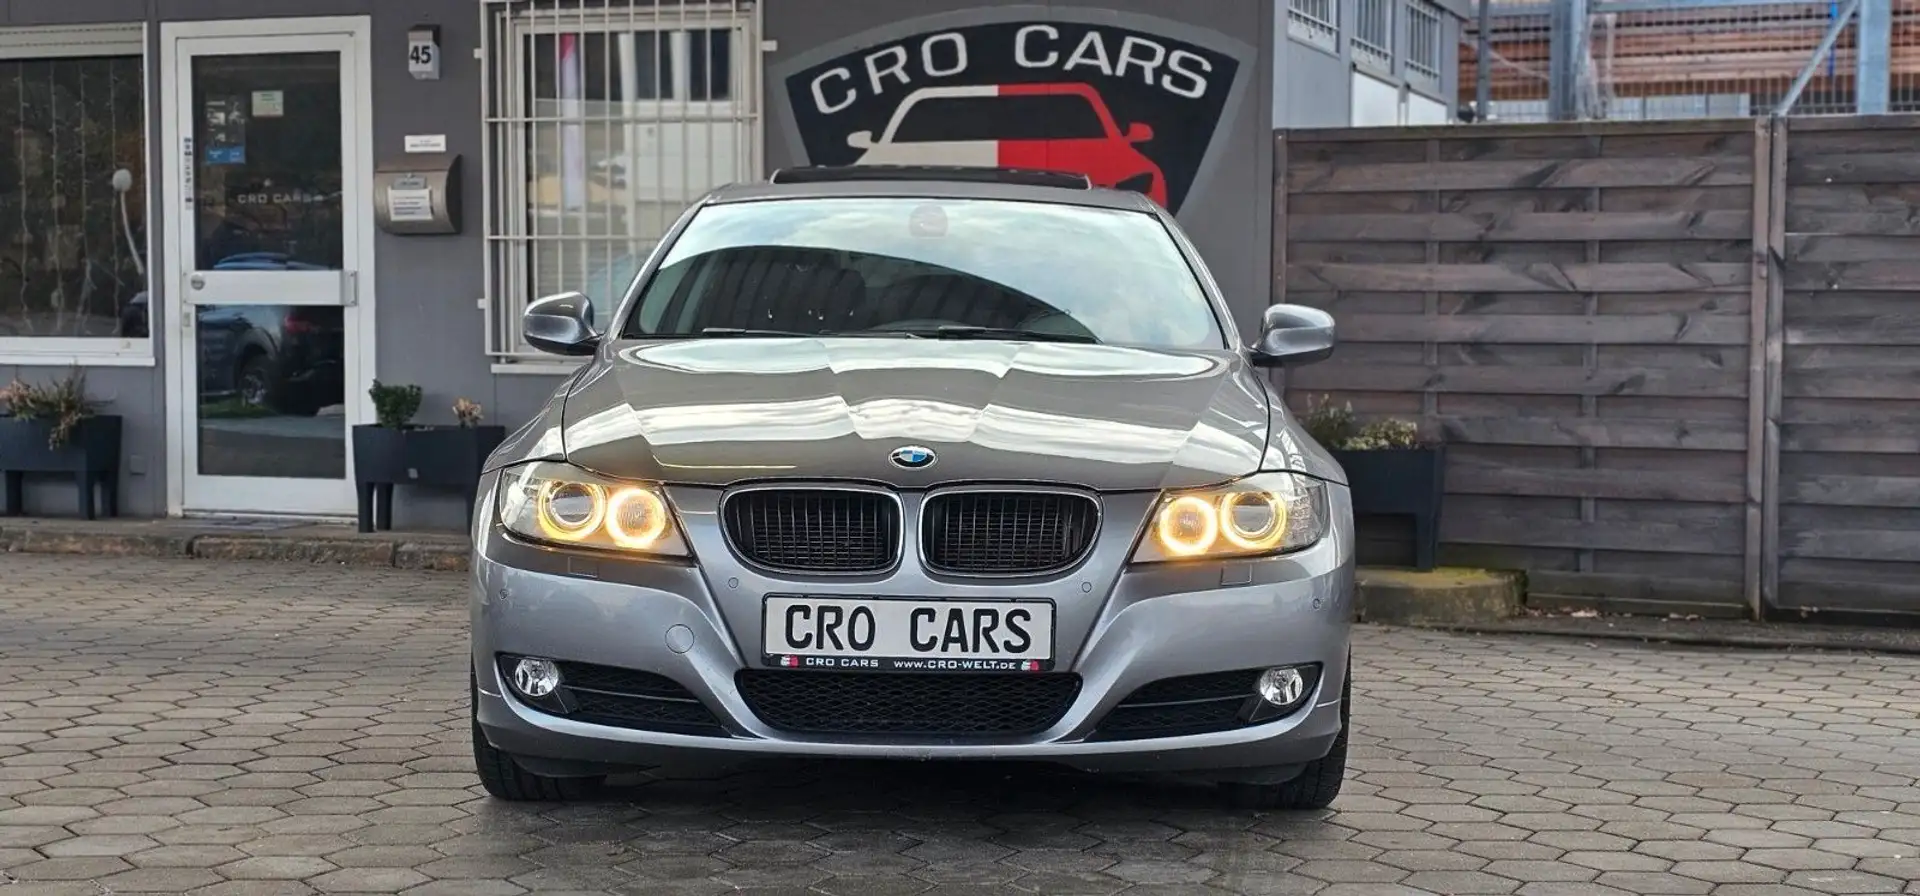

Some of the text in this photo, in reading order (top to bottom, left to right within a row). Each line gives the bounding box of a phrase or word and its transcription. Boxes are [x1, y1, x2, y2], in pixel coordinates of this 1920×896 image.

[410, 45, 432, 65] 45
[810, 24, 1213, 115] CRO CARS
[785, 604, 1032, 654] CRO CARS
[805, 657, 835, 667] CRO
[841, 658, 880, 668] CARS
